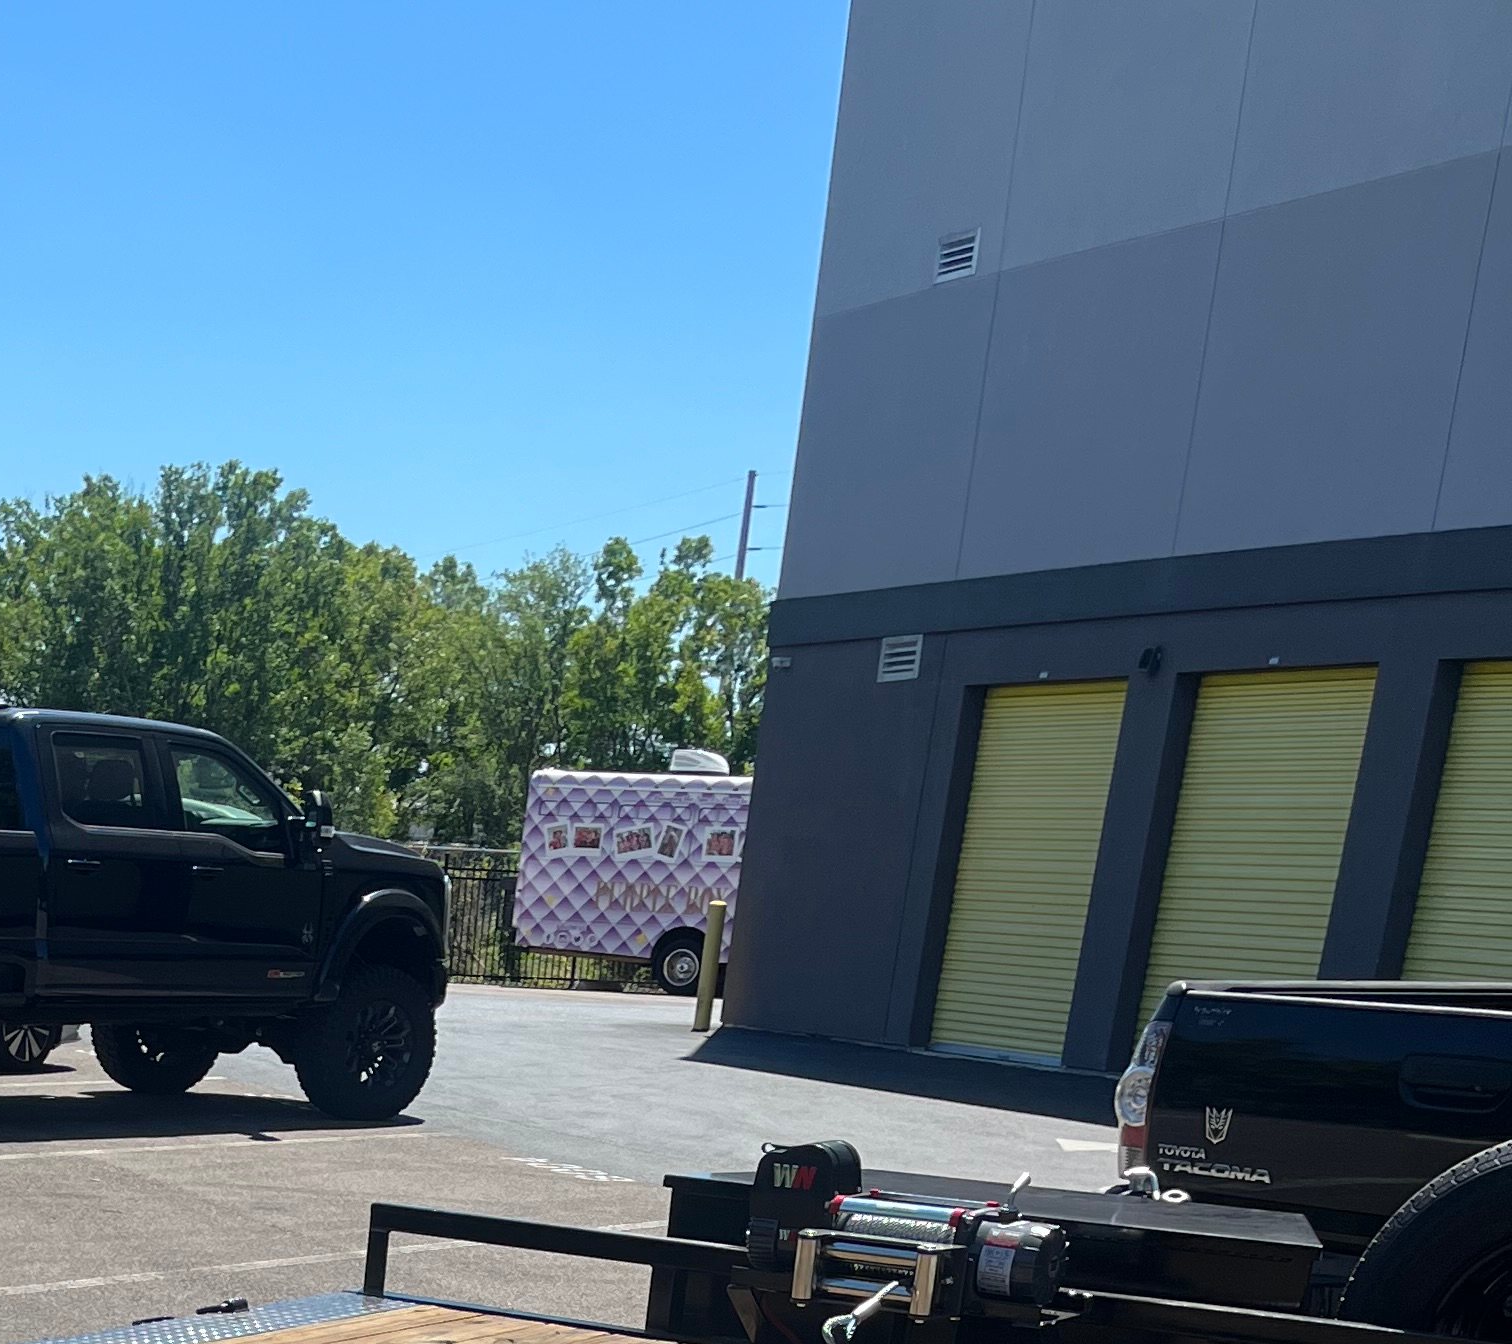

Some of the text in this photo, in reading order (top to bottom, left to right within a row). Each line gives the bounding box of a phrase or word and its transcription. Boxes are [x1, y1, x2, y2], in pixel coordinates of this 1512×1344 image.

[1157, 1143, 1206, 1160] TOYOTA
[773, 1163, 818, 1190] WN
[1157, 1157, 1271, 1184] TACOMA
